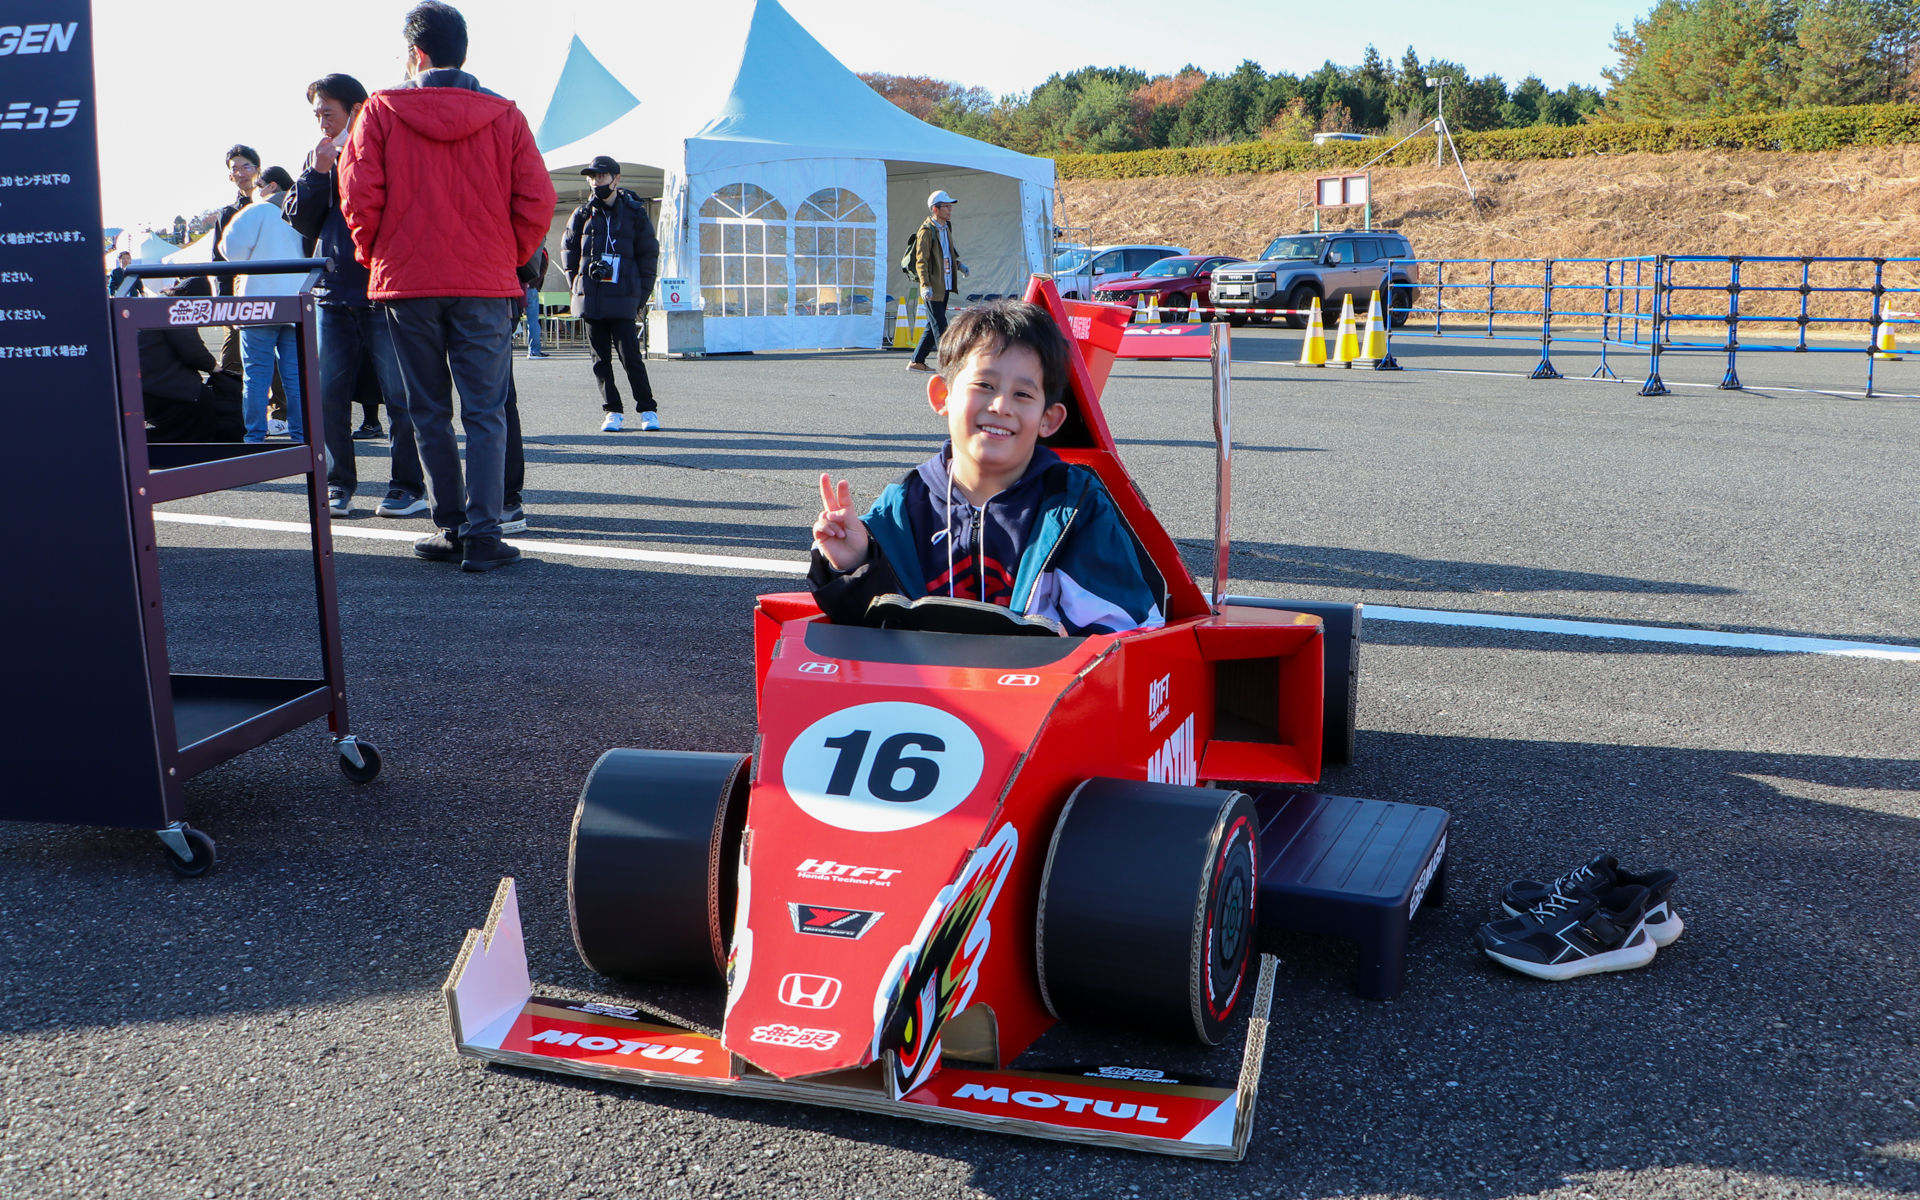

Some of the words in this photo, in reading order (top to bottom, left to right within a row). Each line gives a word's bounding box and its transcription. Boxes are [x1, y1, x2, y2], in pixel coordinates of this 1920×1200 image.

[0, 22, 78, 56] GEN
[0, 99, 81, 130] ミュラ
[212, 301, 276, 322] MUGEN
[1148, 672, 1171, 719] HTFT
[823, 729, 946, 803] 16
[796, 858, 902, 880] HTFT
[797, 871, 830, 881] Honda
[527, 1029, 704, 1064] MOTUL
[750, 1023, 841, 1050] 無限
[1083, 1072, 1130, 1080] MUGEN
[1133, 1076, 1179, 1084] POWER
[951, 1083, 1169, 1124] MOTUL
